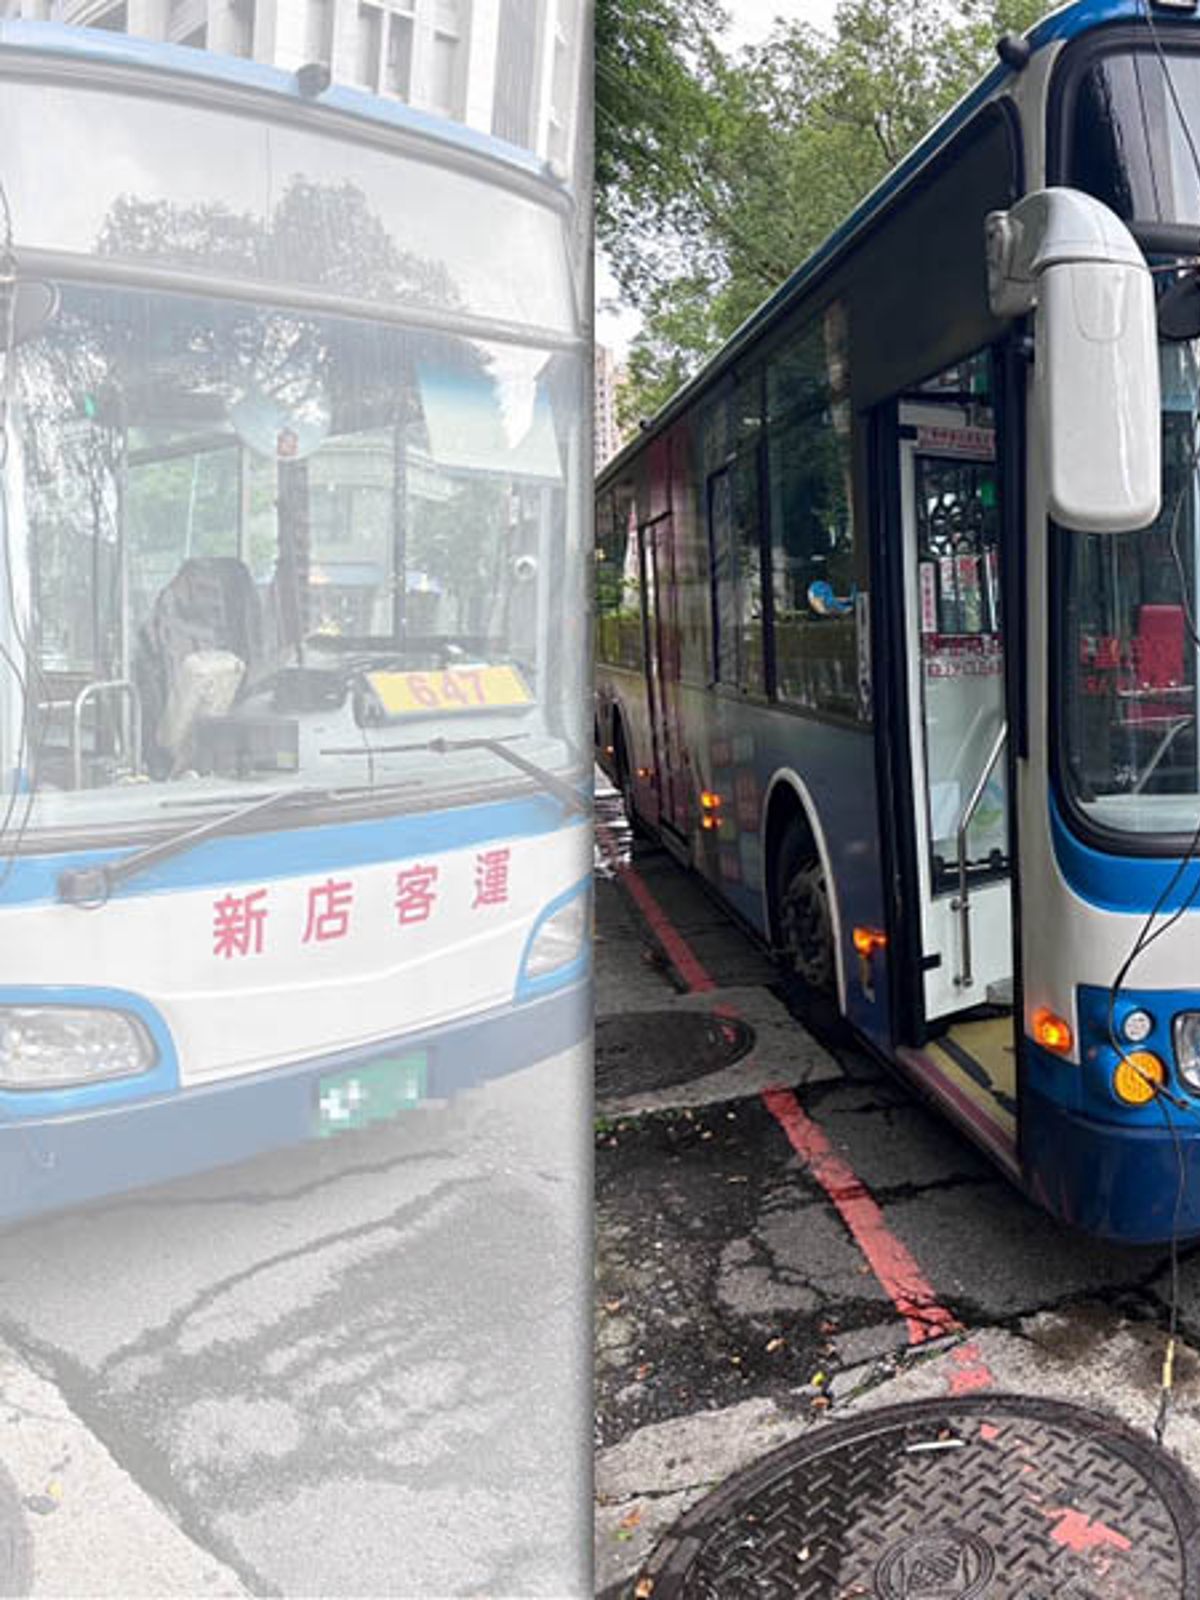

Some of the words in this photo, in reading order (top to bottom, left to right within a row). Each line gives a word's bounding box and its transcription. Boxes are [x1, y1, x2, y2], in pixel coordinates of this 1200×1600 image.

[406, 672, 487, 706] 647
[213, 849, 510, 959] 新店客運
